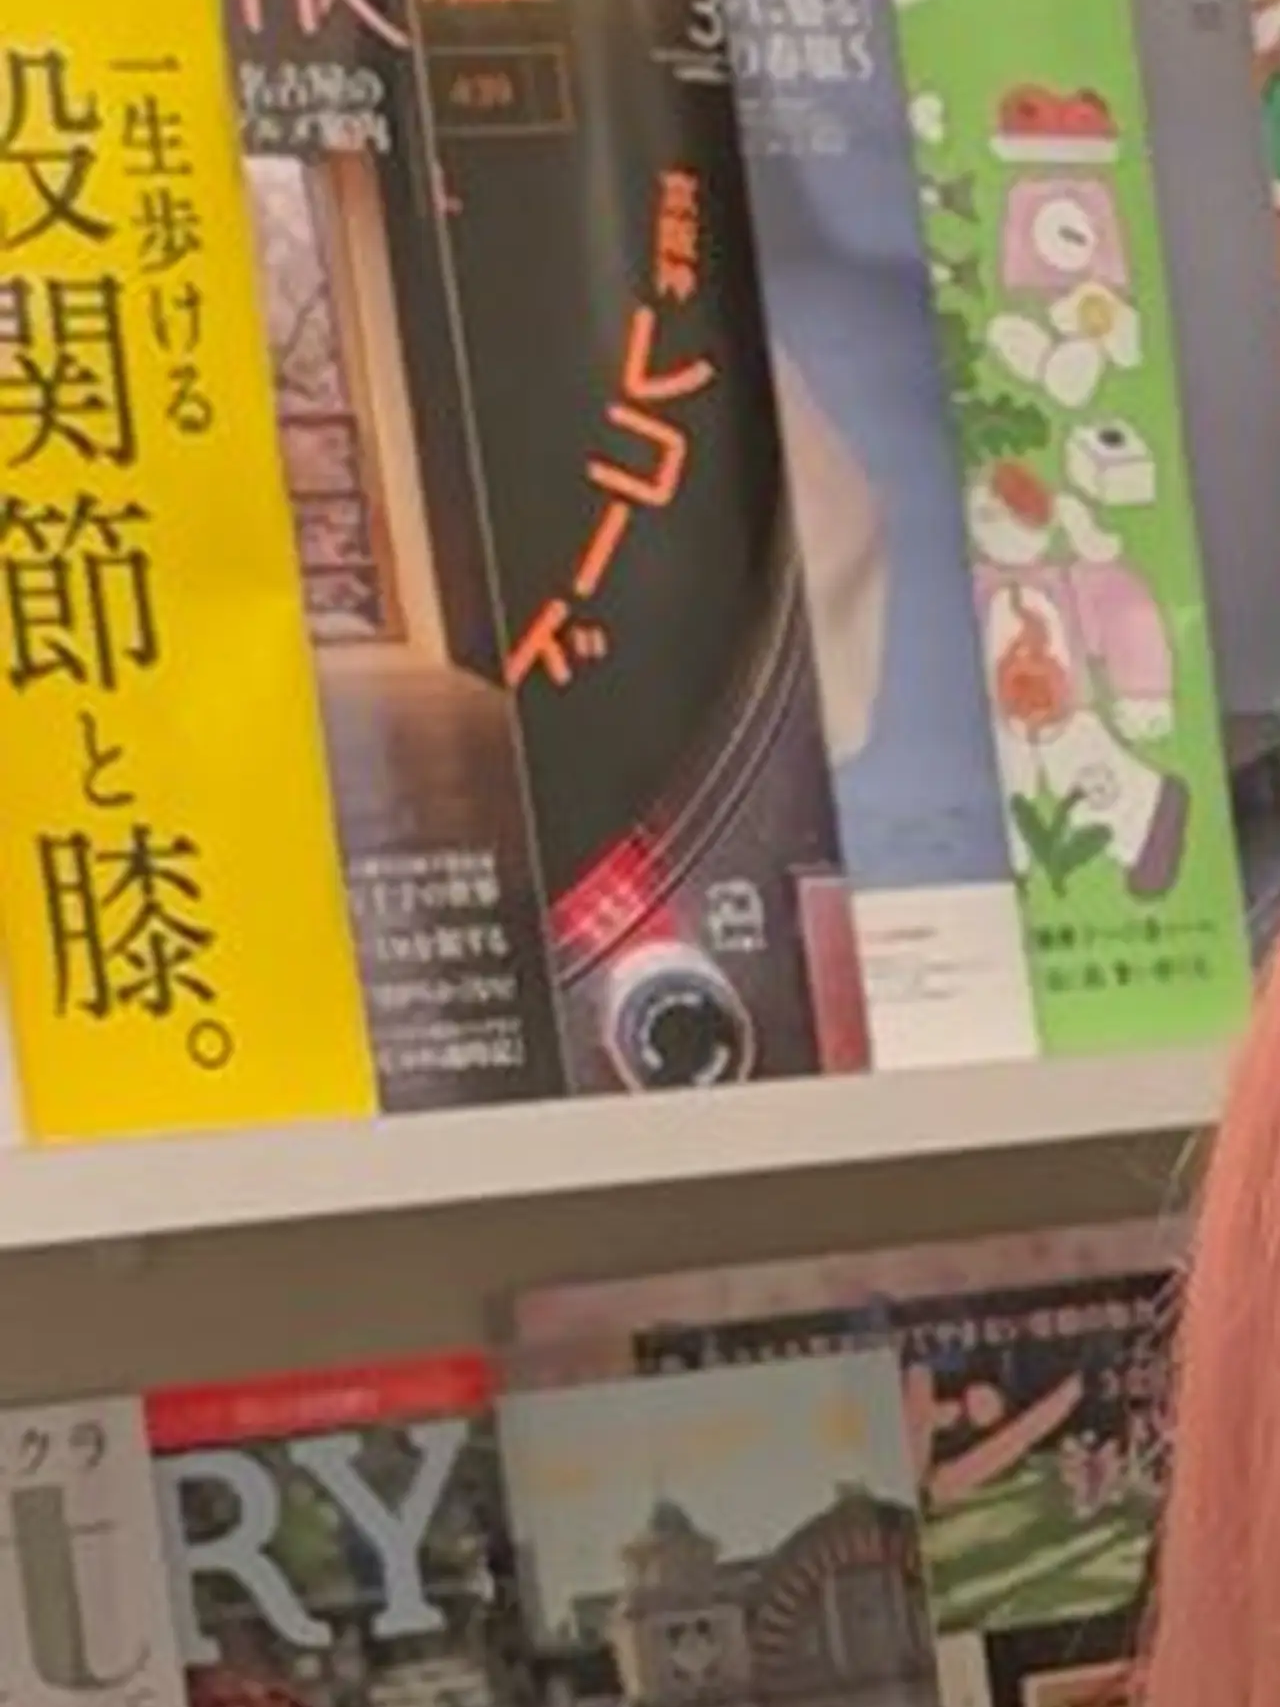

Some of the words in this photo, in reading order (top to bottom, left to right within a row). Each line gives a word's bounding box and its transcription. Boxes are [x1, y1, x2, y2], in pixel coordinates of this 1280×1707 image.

[107, 55, 213, 435] 一生歩ける
[501, 304, 714, 687] レコード
